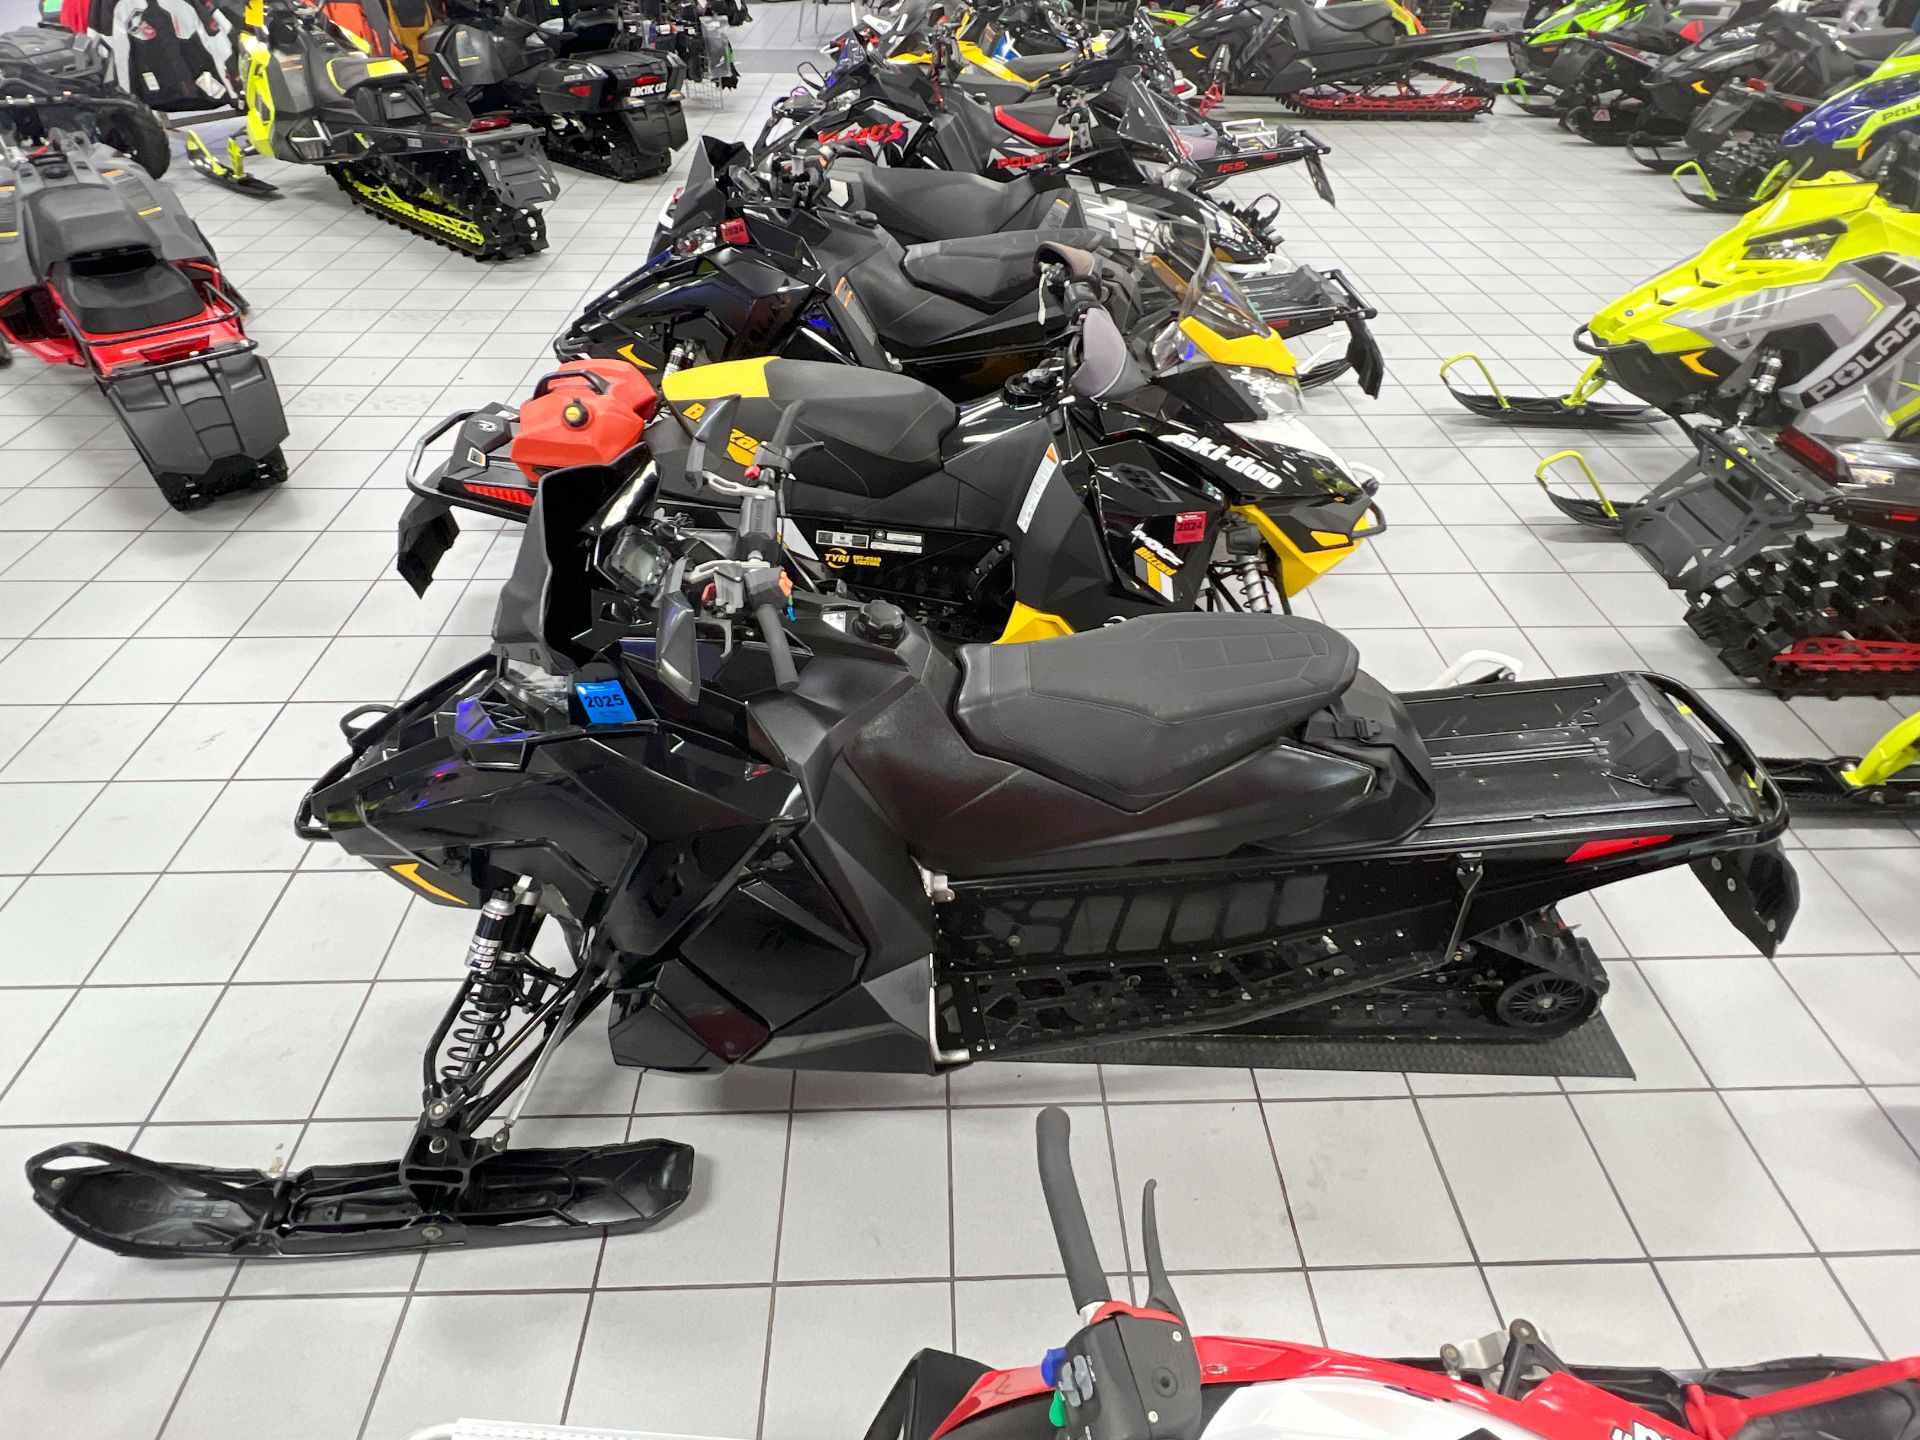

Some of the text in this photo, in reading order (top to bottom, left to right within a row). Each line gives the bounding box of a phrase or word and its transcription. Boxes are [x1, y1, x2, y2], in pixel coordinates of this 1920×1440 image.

[630, 81, 668, 97] ARCTIC CAT
[724, 225, 744, 236] 2024
[1808, 303, 1920, 402] POLAR
[1176, 521, 1203, 532] 2024
[824, 553, 851, 563] TYRI
[585, 693, 625, 708] 2025
